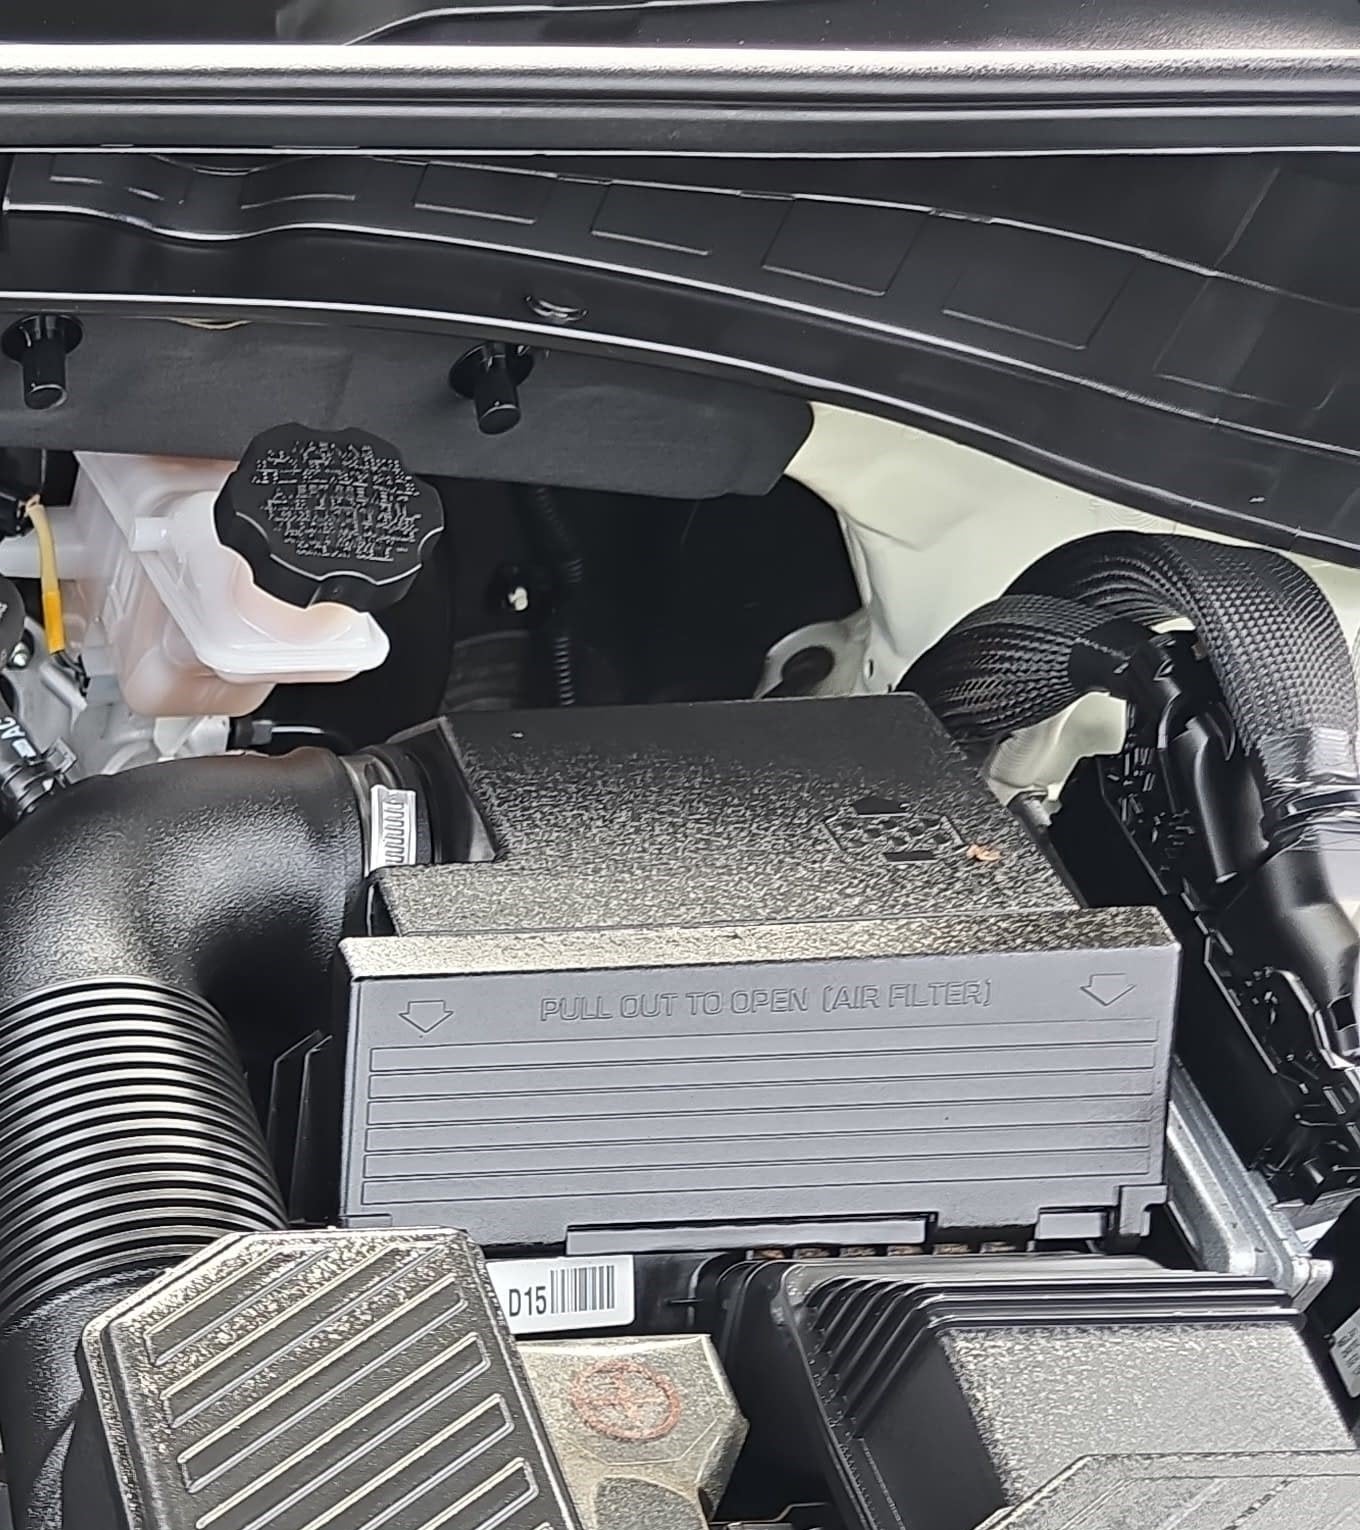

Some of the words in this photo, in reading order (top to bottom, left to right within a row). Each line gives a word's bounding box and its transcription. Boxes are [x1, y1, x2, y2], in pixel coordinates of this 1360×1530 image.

[539, 994, 614, 1023] PULL
[619, 992, 679, 1019] OUT
[684, 990, 721, 1017] TO
[729, 986, 809, 1015] OPEN
[821, 982, 881, 1014] (AIR
[888, 978, 993, 1010] FILTER)
[508, 1286, 547, 1317] D15
